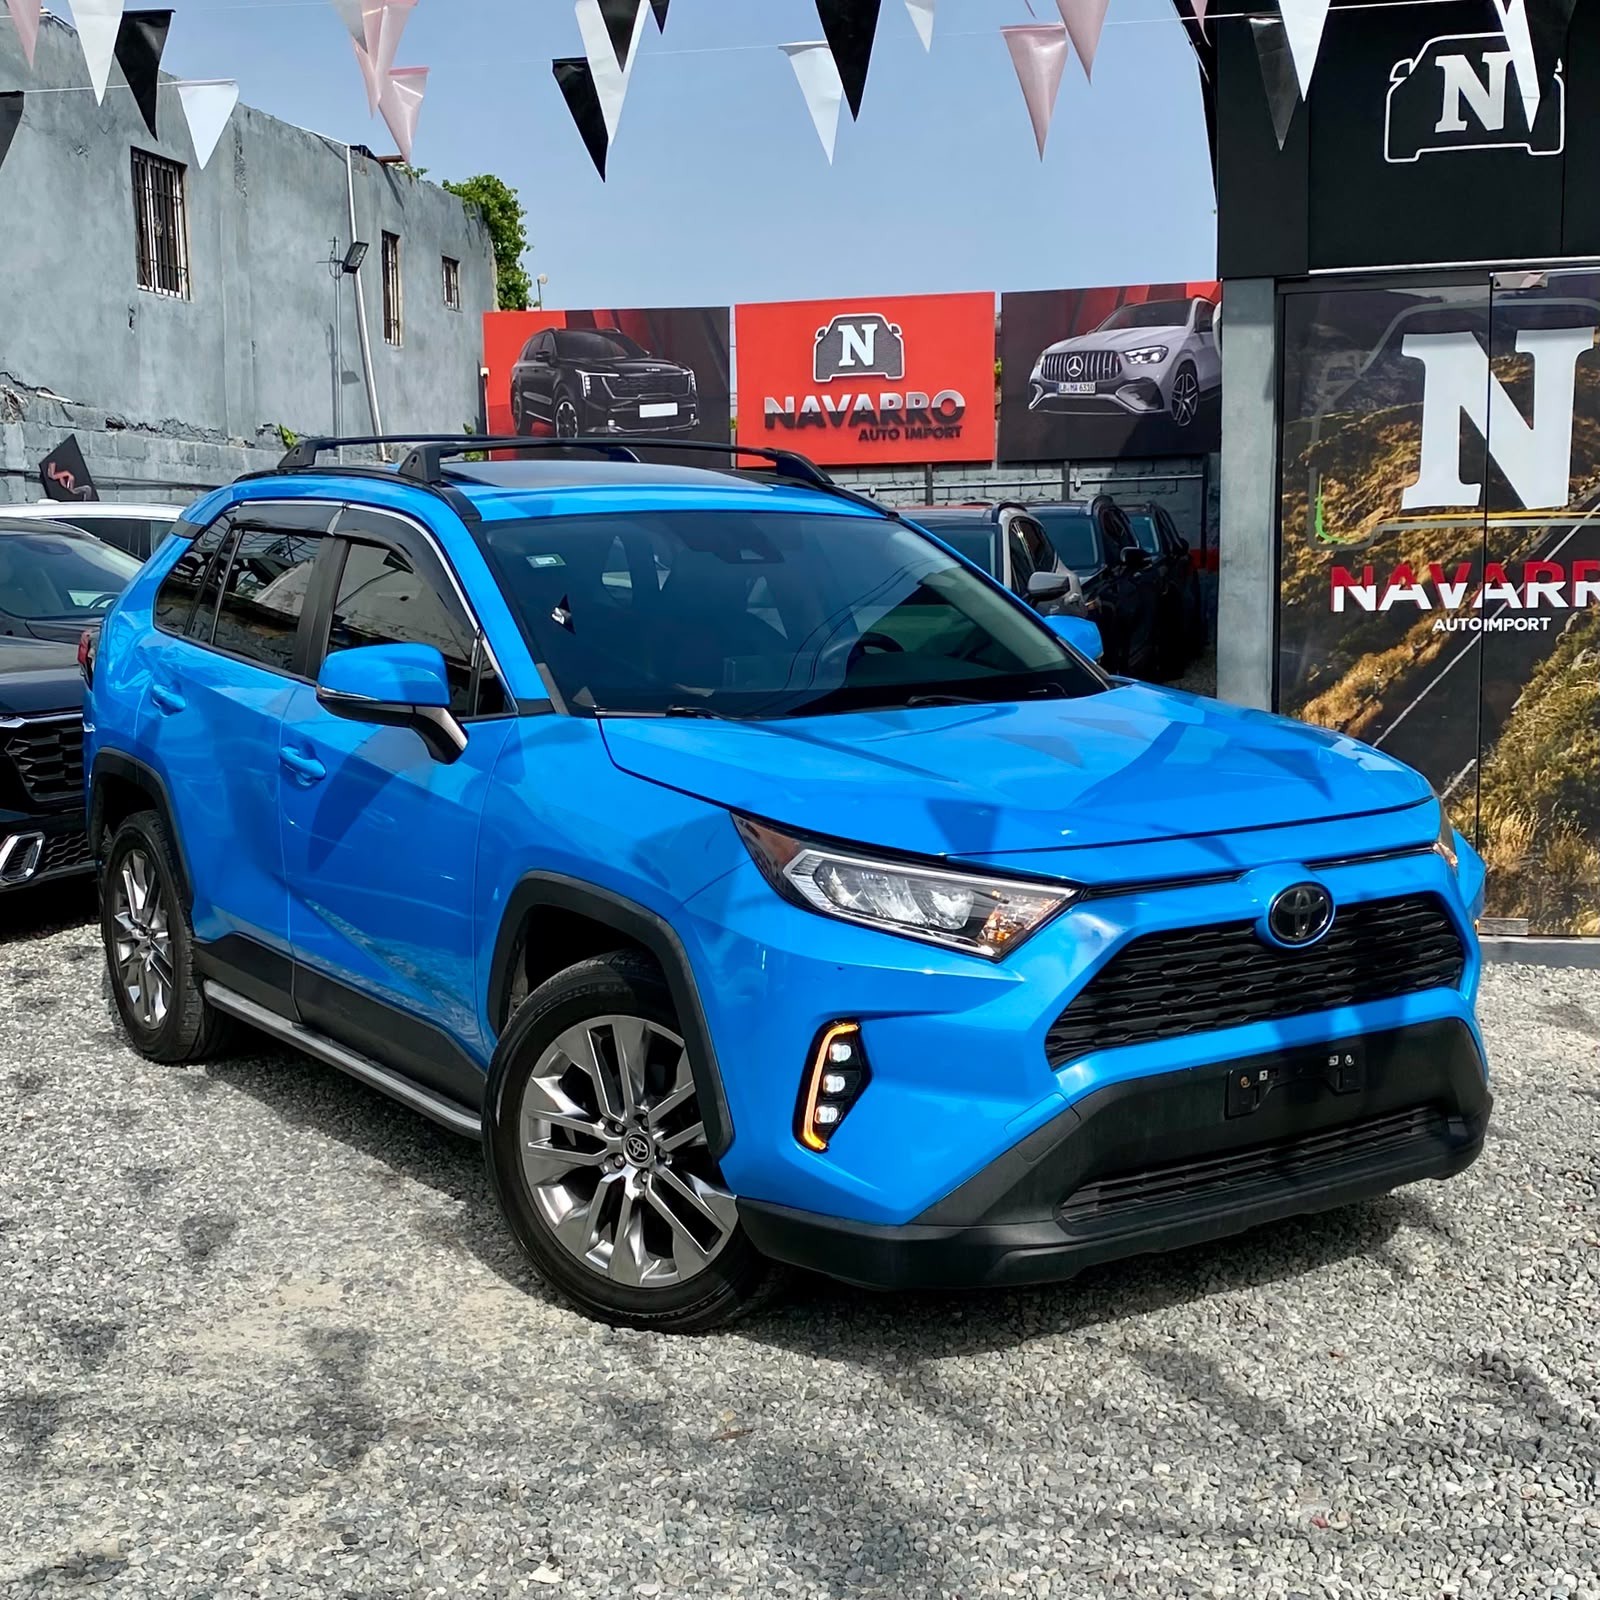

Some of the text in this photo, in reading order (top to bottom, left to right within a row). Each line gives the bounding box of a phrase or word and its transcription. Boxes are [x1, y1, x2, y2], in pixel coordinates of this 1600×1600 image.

[1434, 51, 1513, 133] N
[837, 323, 878, 367] N
[763, 389, 966, 429] NAVARRO
[1401, 326, 1596, 510] N
[858, 425, 963, 442] AUTO IMPORT
